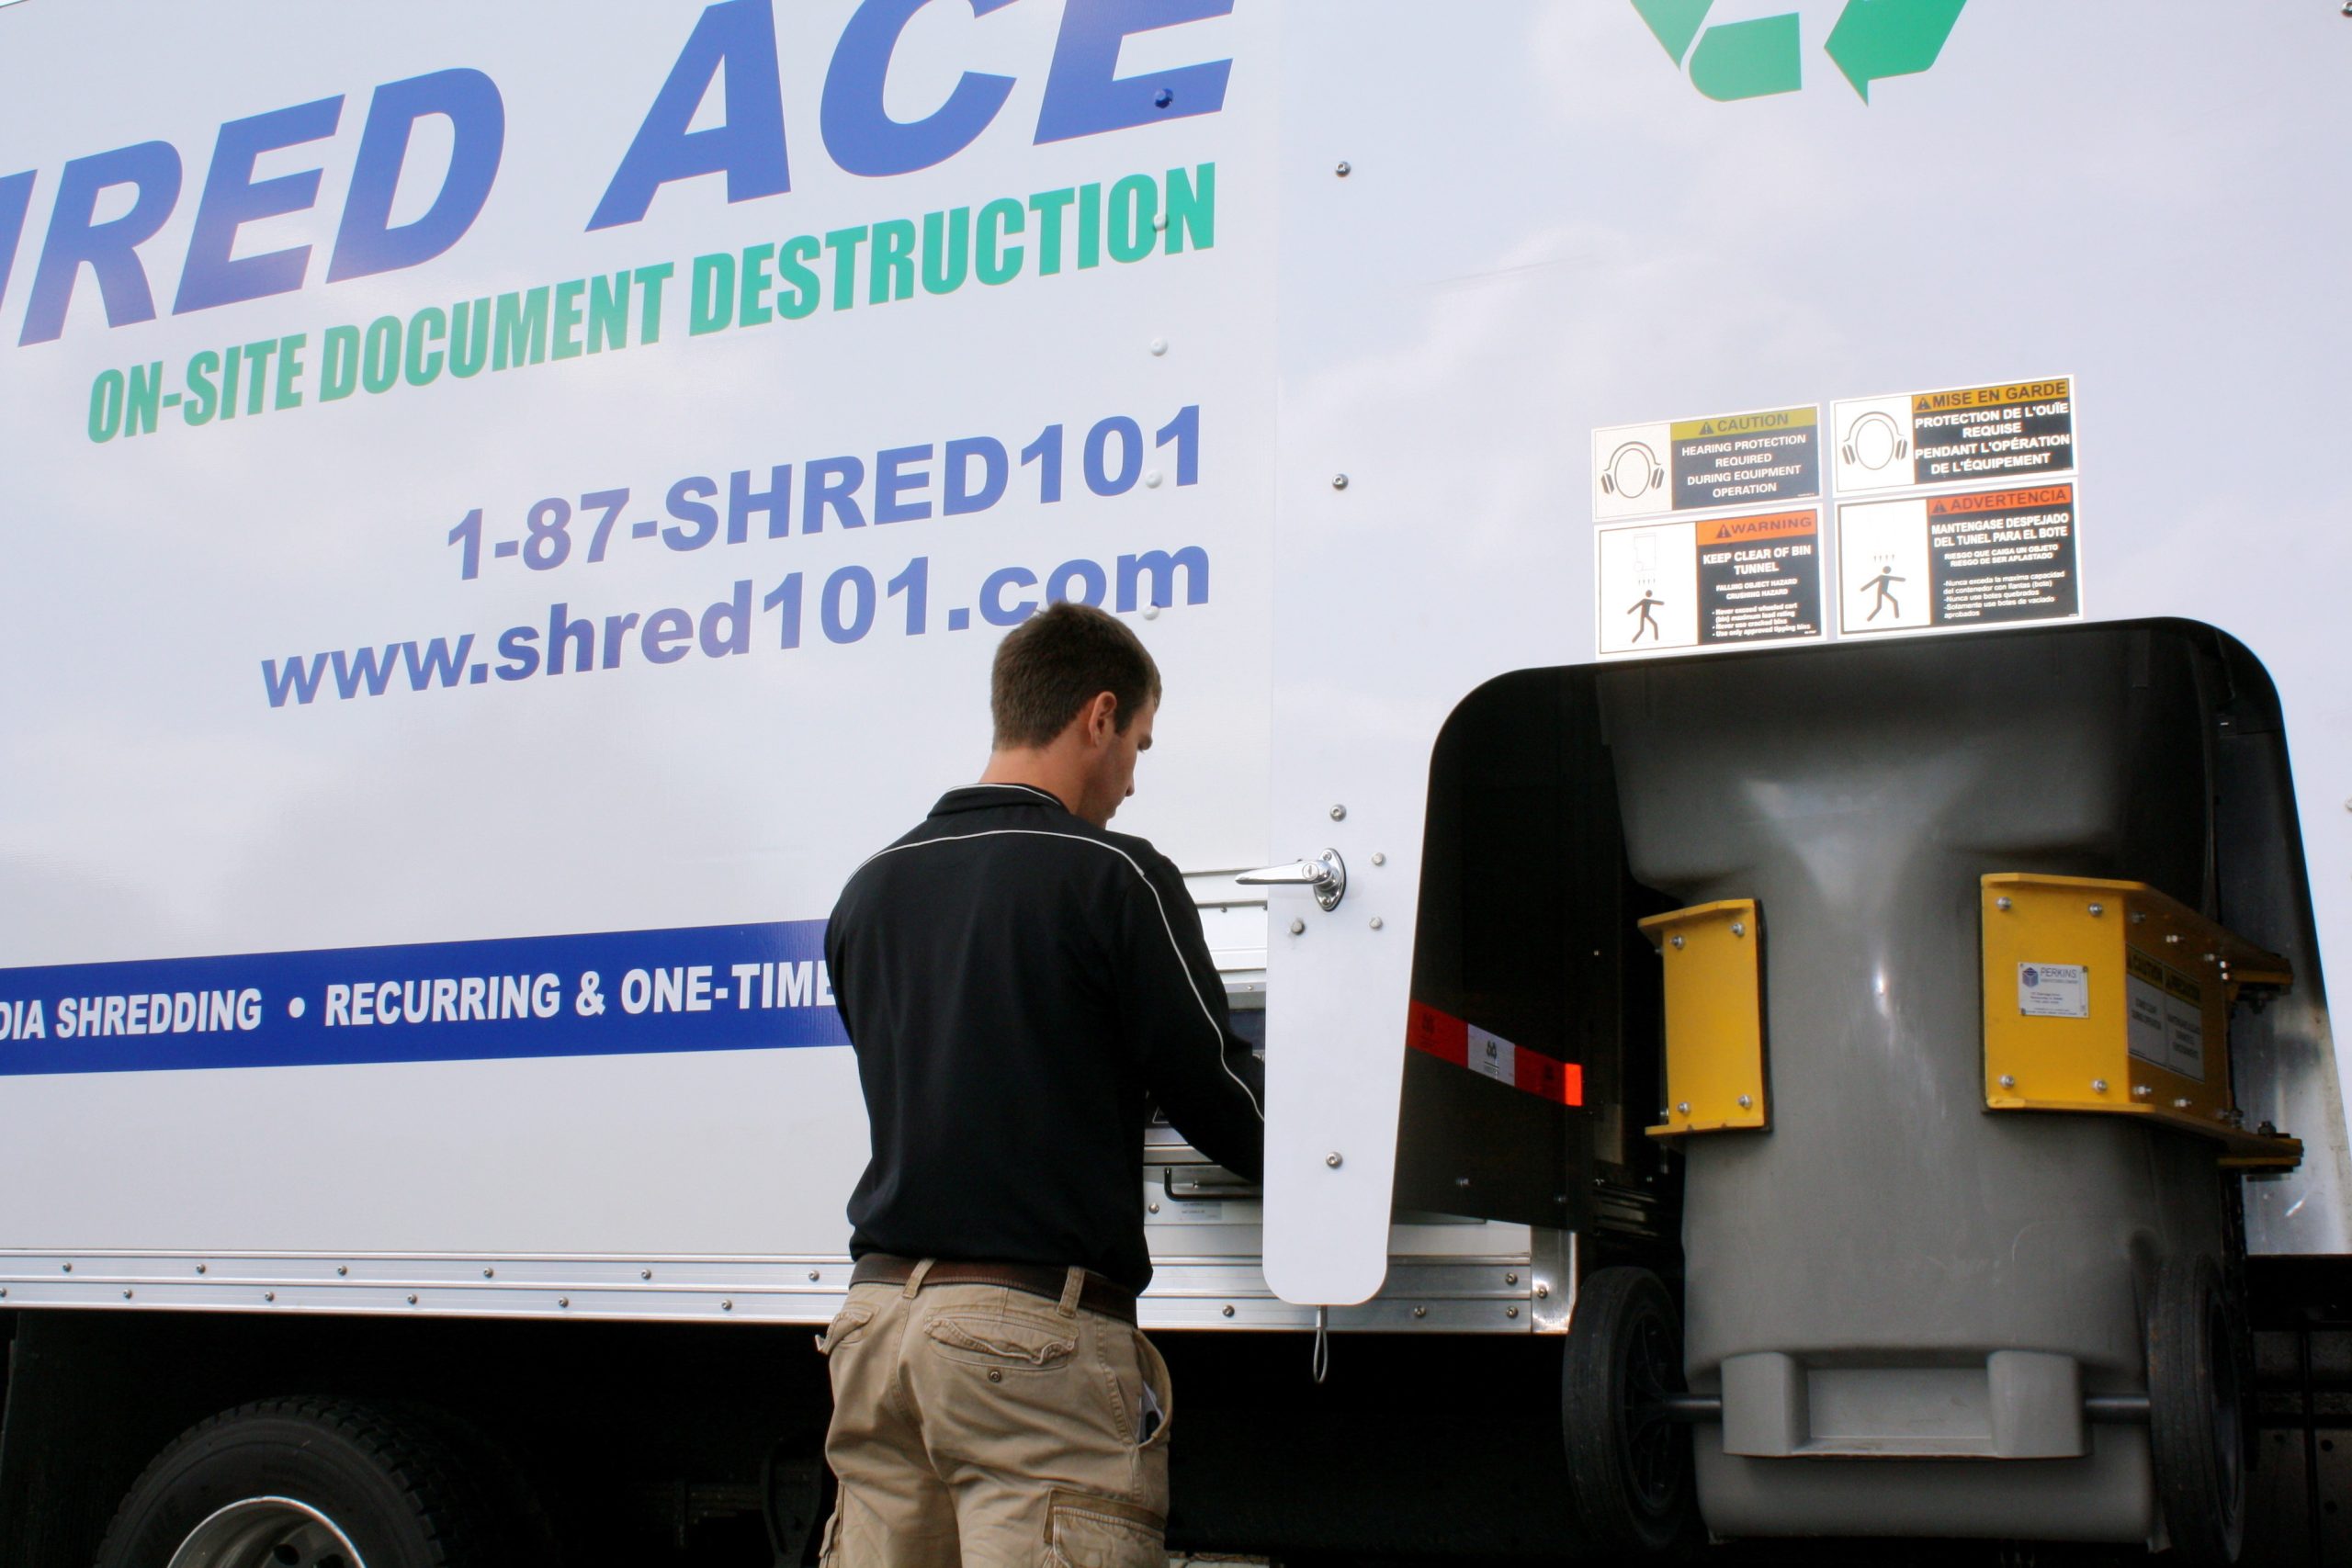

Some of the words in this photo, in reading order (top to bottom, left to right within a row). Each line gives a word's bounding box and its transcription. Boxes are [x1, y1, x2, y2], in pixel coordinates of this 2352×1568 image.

[0, 67, 505, 348] RED
[584, 0, 1235, 233] ACE
[87, 333, 307, 444] ON-SITE
[318, 261, 674, 403] DOCUMENT
[689, 162, 1216, 337] DESTRUCTION
[1932, 390, 1972, 408] MISE
[1978, 389, 2000, 403] EN
[2006, 381, 2066, 400] GARDE
[1717, 412, 1789, 433] CAUTION
[1915, 411, 2001, 429] PROTECTION
[2003, 407, 2021, 420] DE
[1962, 422, 2022, 438] REQUISE
[1681, 443, 1732, 457] HEARING
[1735, 434, 1807, 451] PROTECTION
[1915, 443, 1978, 459] PENDANT
[1981, 434, 2071, 453] L'OPÉRATION
[1714, 453, 1772, 468] REQUIRED
[1930, 462, 1950, 475] DE
[1952, 452, 2051, 473] L'ÉQUIPEMENT
[1687, 472, 1731, 486] DURING
[1734, 465, 1802, 481] EQUIPMENT
[447, 404, 1200, 581] 1-87-SHRED101
[1712, 482, 1777, 498] OPERATION
[1951, 489, 2066, 512] ADVERTENCIA
[1731, 516, 1812, 535] WARNING
[1931, 517, 2004, 535] MANTENGASE
[2006, 512, 2069, 529] DESPEJADO
[1934, 536, 1955, 547] DEL
[1956, 532, 1991, 546] TUNEL
[1992, 529, 2021, 543] PARA
[2022, 528, 2037, 540] EL
[2039, 525, 2068, 538] BOTE
[1702, 552, 1732, 565] KEEP
[1734, 548, 1771, 562] CLEAR
[1773, 547, 1790, 558] OF
[1792, 545, 1811, 557] BIN
[1734, 562, 1780, 575] TUNNEL
[1761, 588, 1789, 597] HAZARD
[1770, 578, 1798, 587] HAZARD
[261, 545, 1210, 708] www.shred101.com
[2040, 967, 2077, 978] PERKINS
[324, 972, 560, 1027] RECURRING
[575, 970, 606, 1016] &
[55, 987, 262, 1039] SHREDDING
